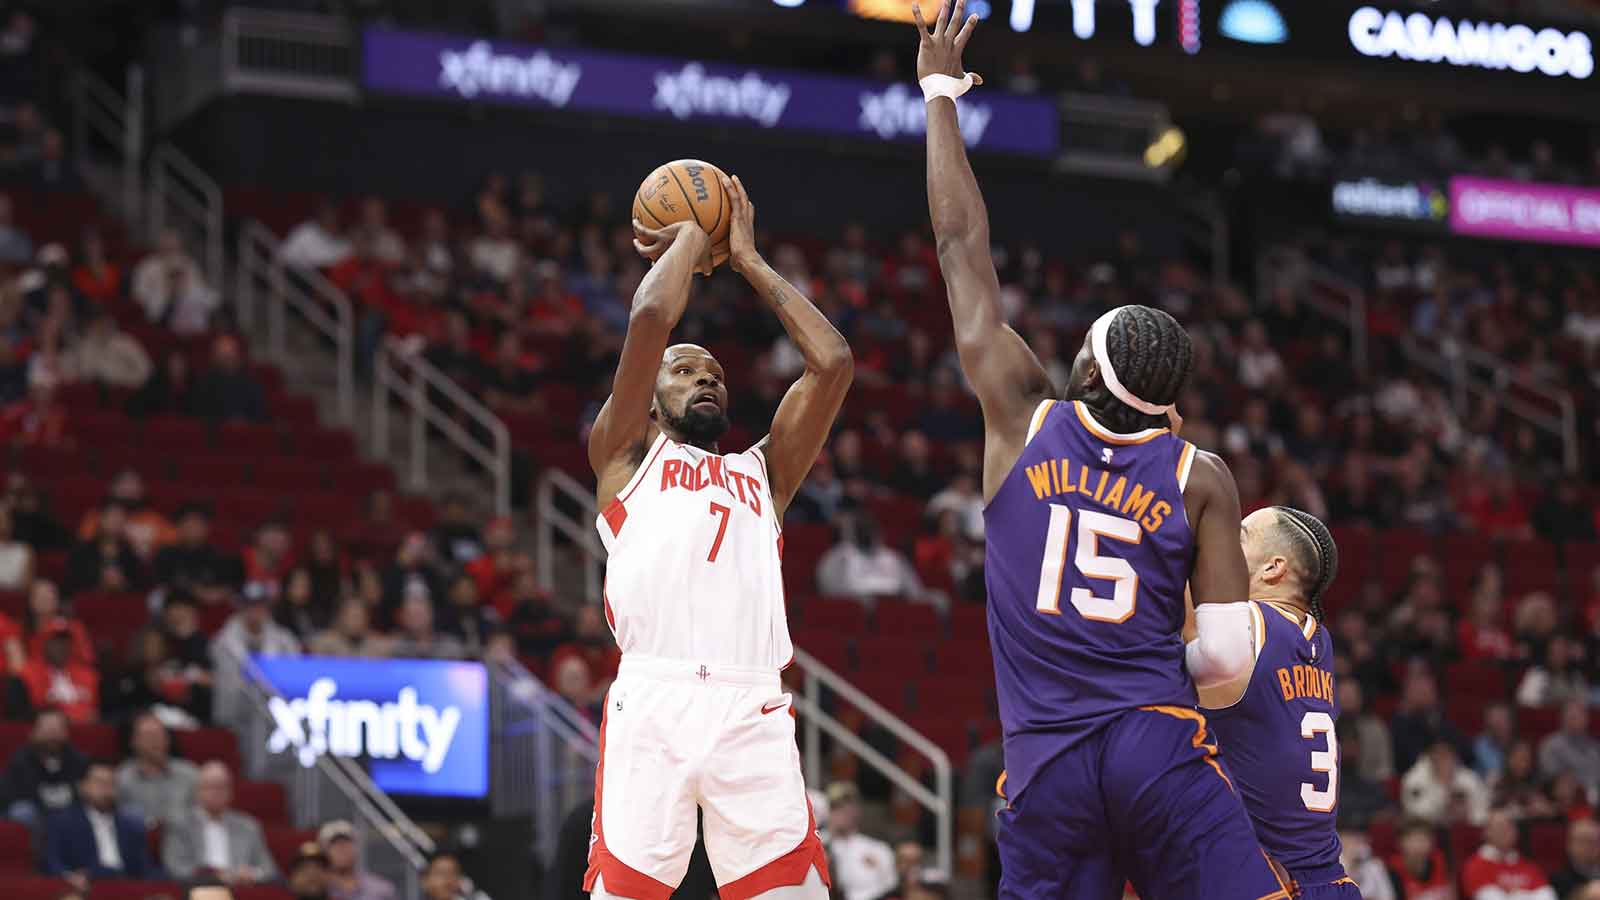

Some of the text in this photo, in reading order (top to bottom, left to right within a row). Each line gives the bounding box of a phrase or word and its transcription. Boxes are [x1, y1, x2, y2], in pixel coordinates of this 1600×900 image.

[439, 41, 580, 107] xfinity
[1349, 6, 1593, 79] CASAMIGOS
[654, 62, 791, 127] xfinity
[706, 501, 732, 563] 7
[1025, 458, 1173, 533] WILLIAMS
[1036, 503, 1143, 624] 15
[1276, 664, 1334, 707] BROOK
[267, 676, 462, 774] xfinity
[1300, 711, 1338, 813] 3
